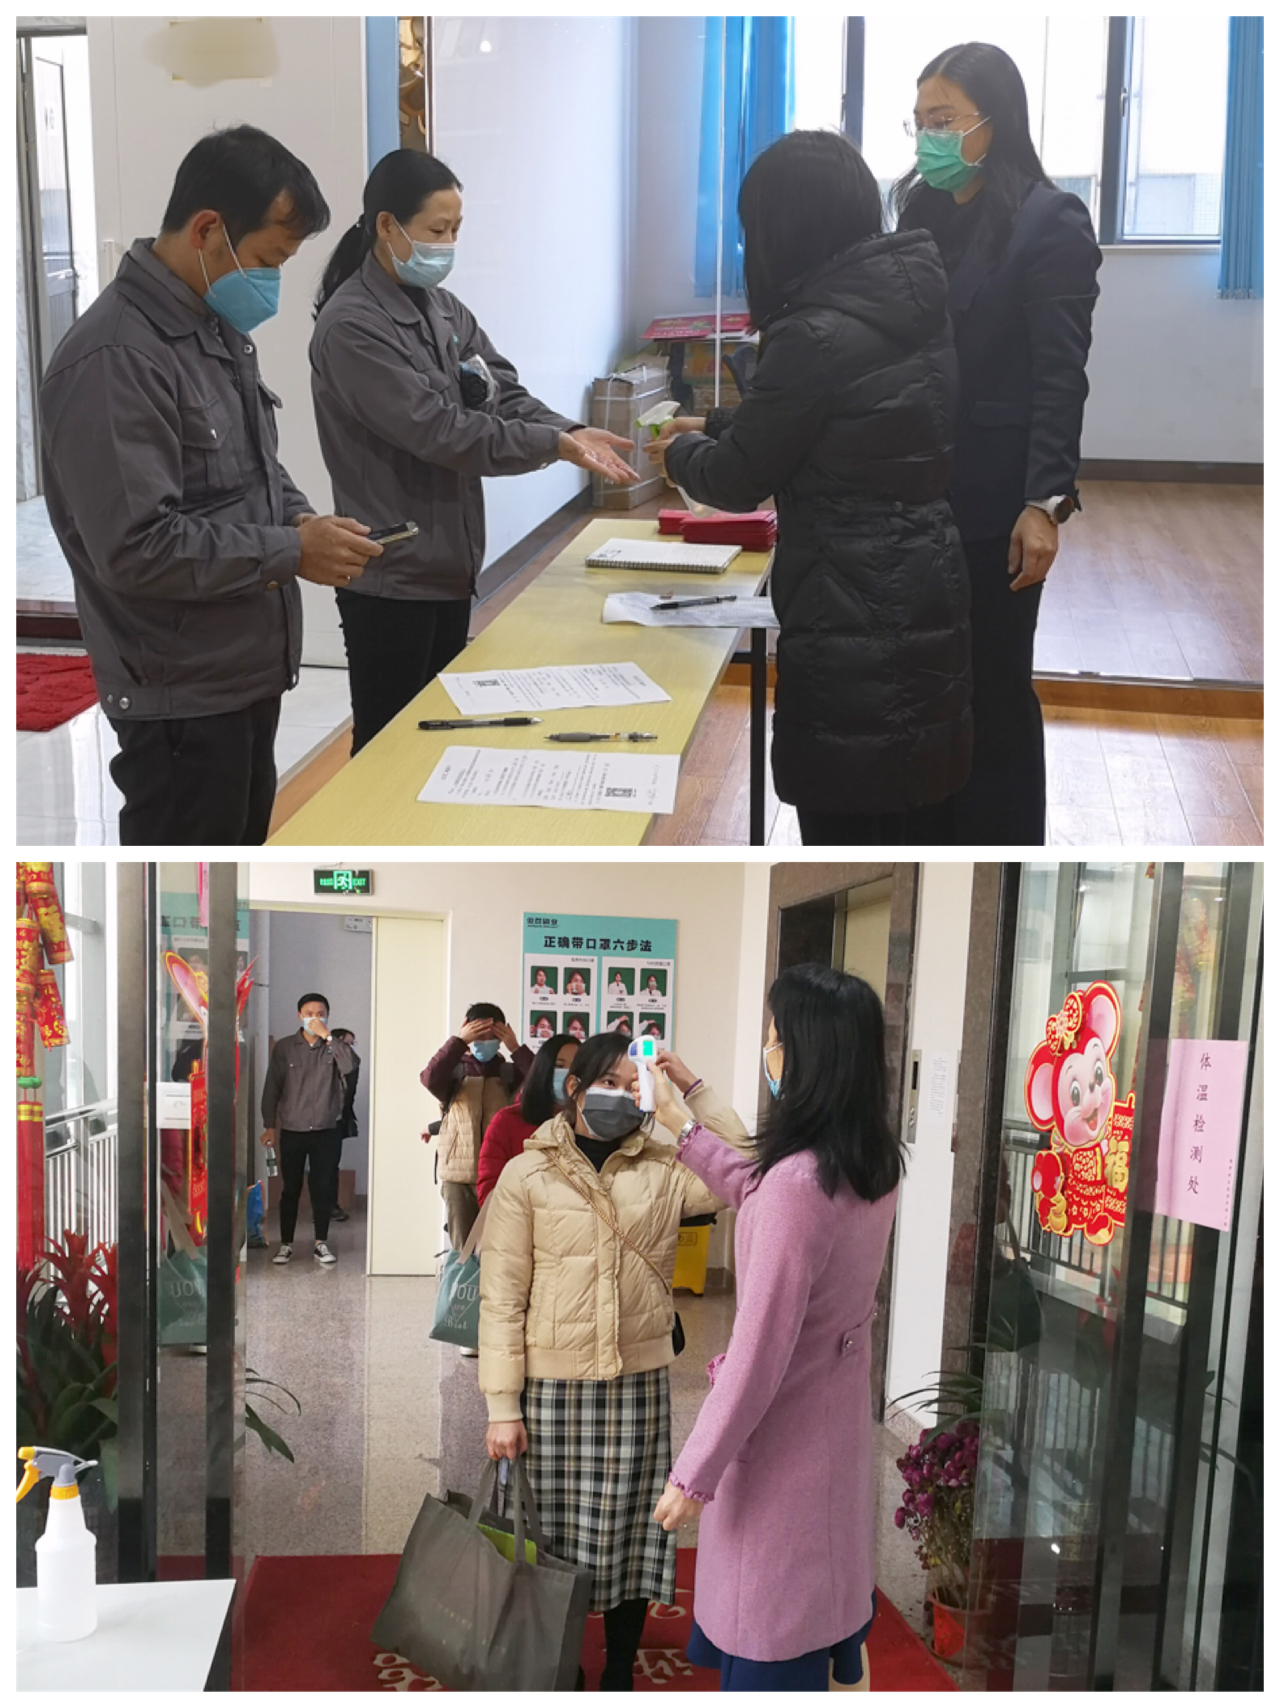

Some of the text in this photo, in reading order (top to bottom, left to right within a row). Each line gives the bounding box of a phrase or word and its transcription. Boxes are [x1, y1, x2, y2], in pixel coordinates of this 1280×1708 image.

[353, 877, 366, 886] EXIT
[543, 935, 653, 953] 正确带口罩六步法
[1187, 1052, 1212, 1195] 体温检测处
[1105, 1137, 1130, 1192] 福
